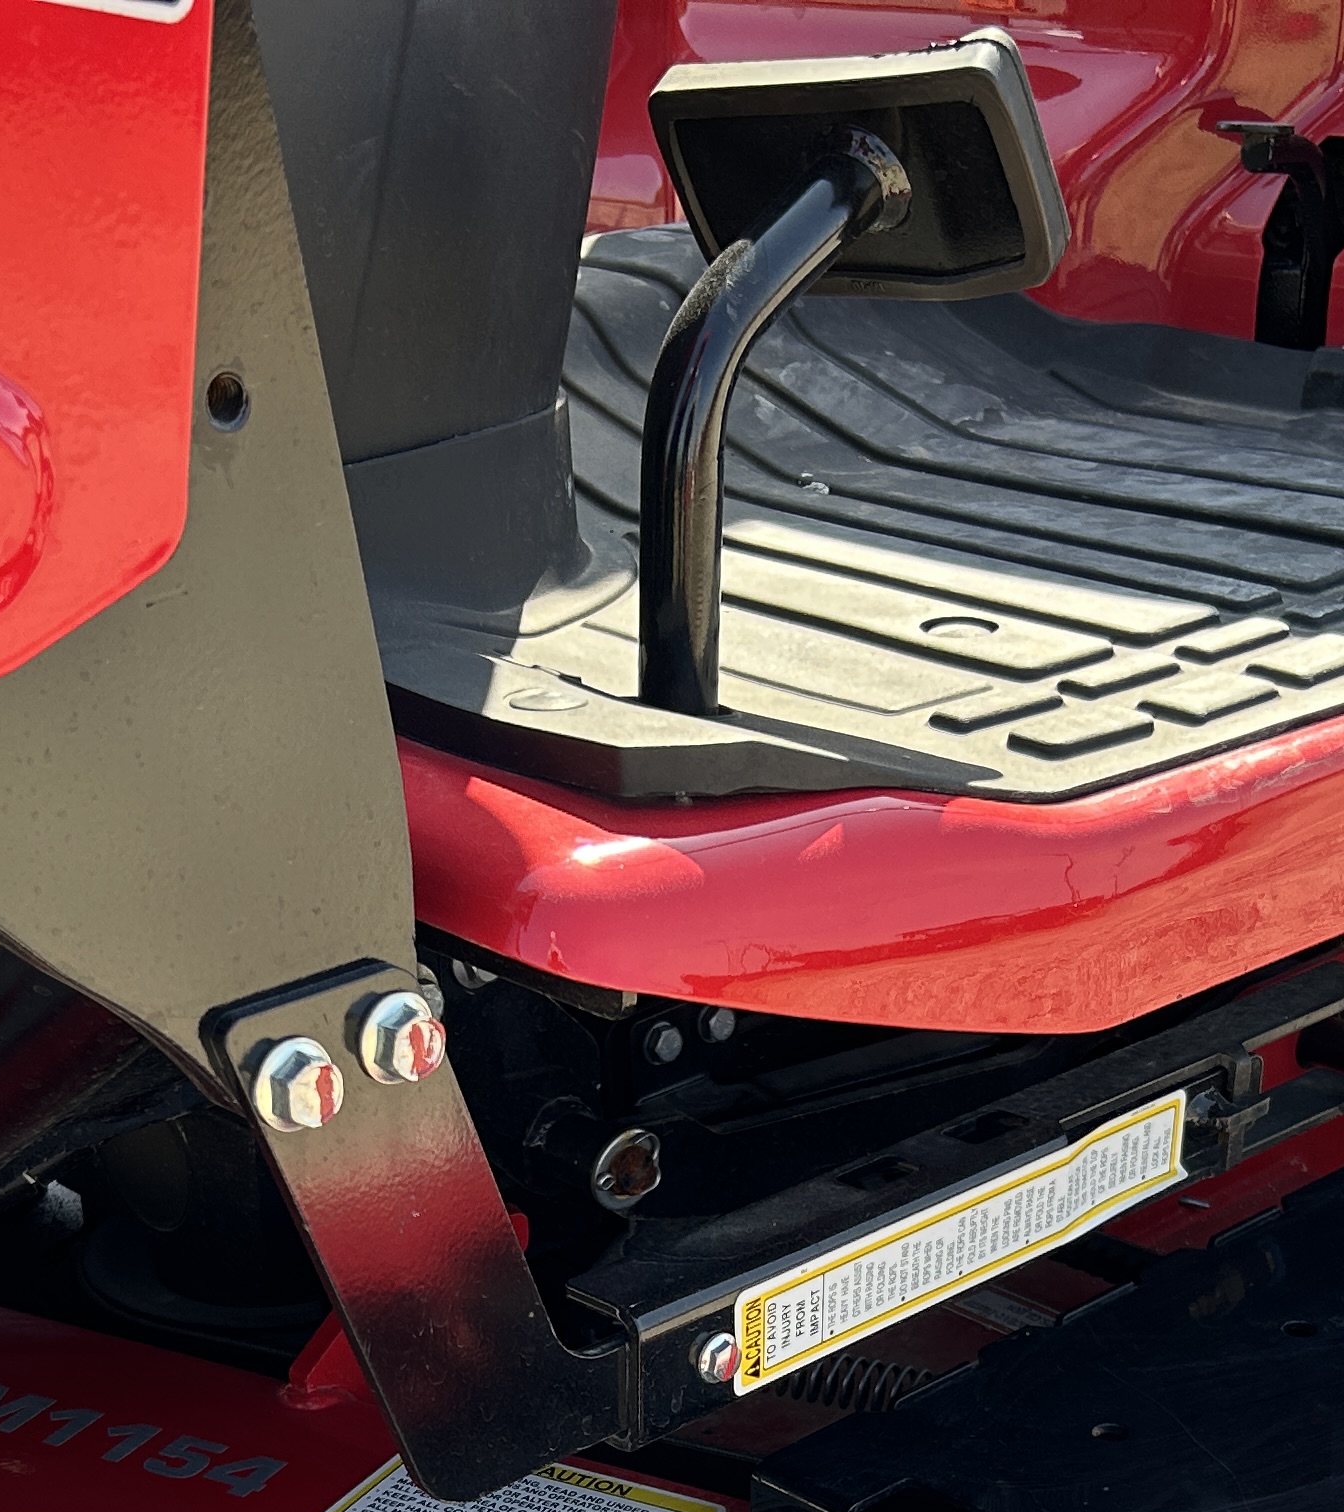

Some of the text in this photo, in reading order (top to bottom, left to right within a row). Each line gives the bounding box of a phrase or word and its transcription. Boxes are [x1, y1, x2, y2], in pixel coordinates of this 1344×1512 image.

[796, 1299, 805, 1337] FROM
[810, 1286, 819, 1336] IMPACT
[745, 1297, 760, 1361] CAUTION
[766, 1301, 776, 1363] TO AVOID
[781, 1301, 790, 1349] INJURY
[388, 1483, 413, 1493] ALL
[537, 1465, 633, 1496] AUTION
[381, 1489, 417, 1502] KEEP
[415, 1499, 443, 1509] ALL
[500, 1489, 522, 1498] OR
[520, 1494, 560, 1508] ALTER
[519, 1486, 547, 1496] AND
[542, 1484, 579, 1497] READ
[577, 1493, 606, 1504] AND
[365, 1502, 391, 1512] ALL
[372, 1496, 406, 1508] KEEP
[497, 1504, 515, 1512] OF
